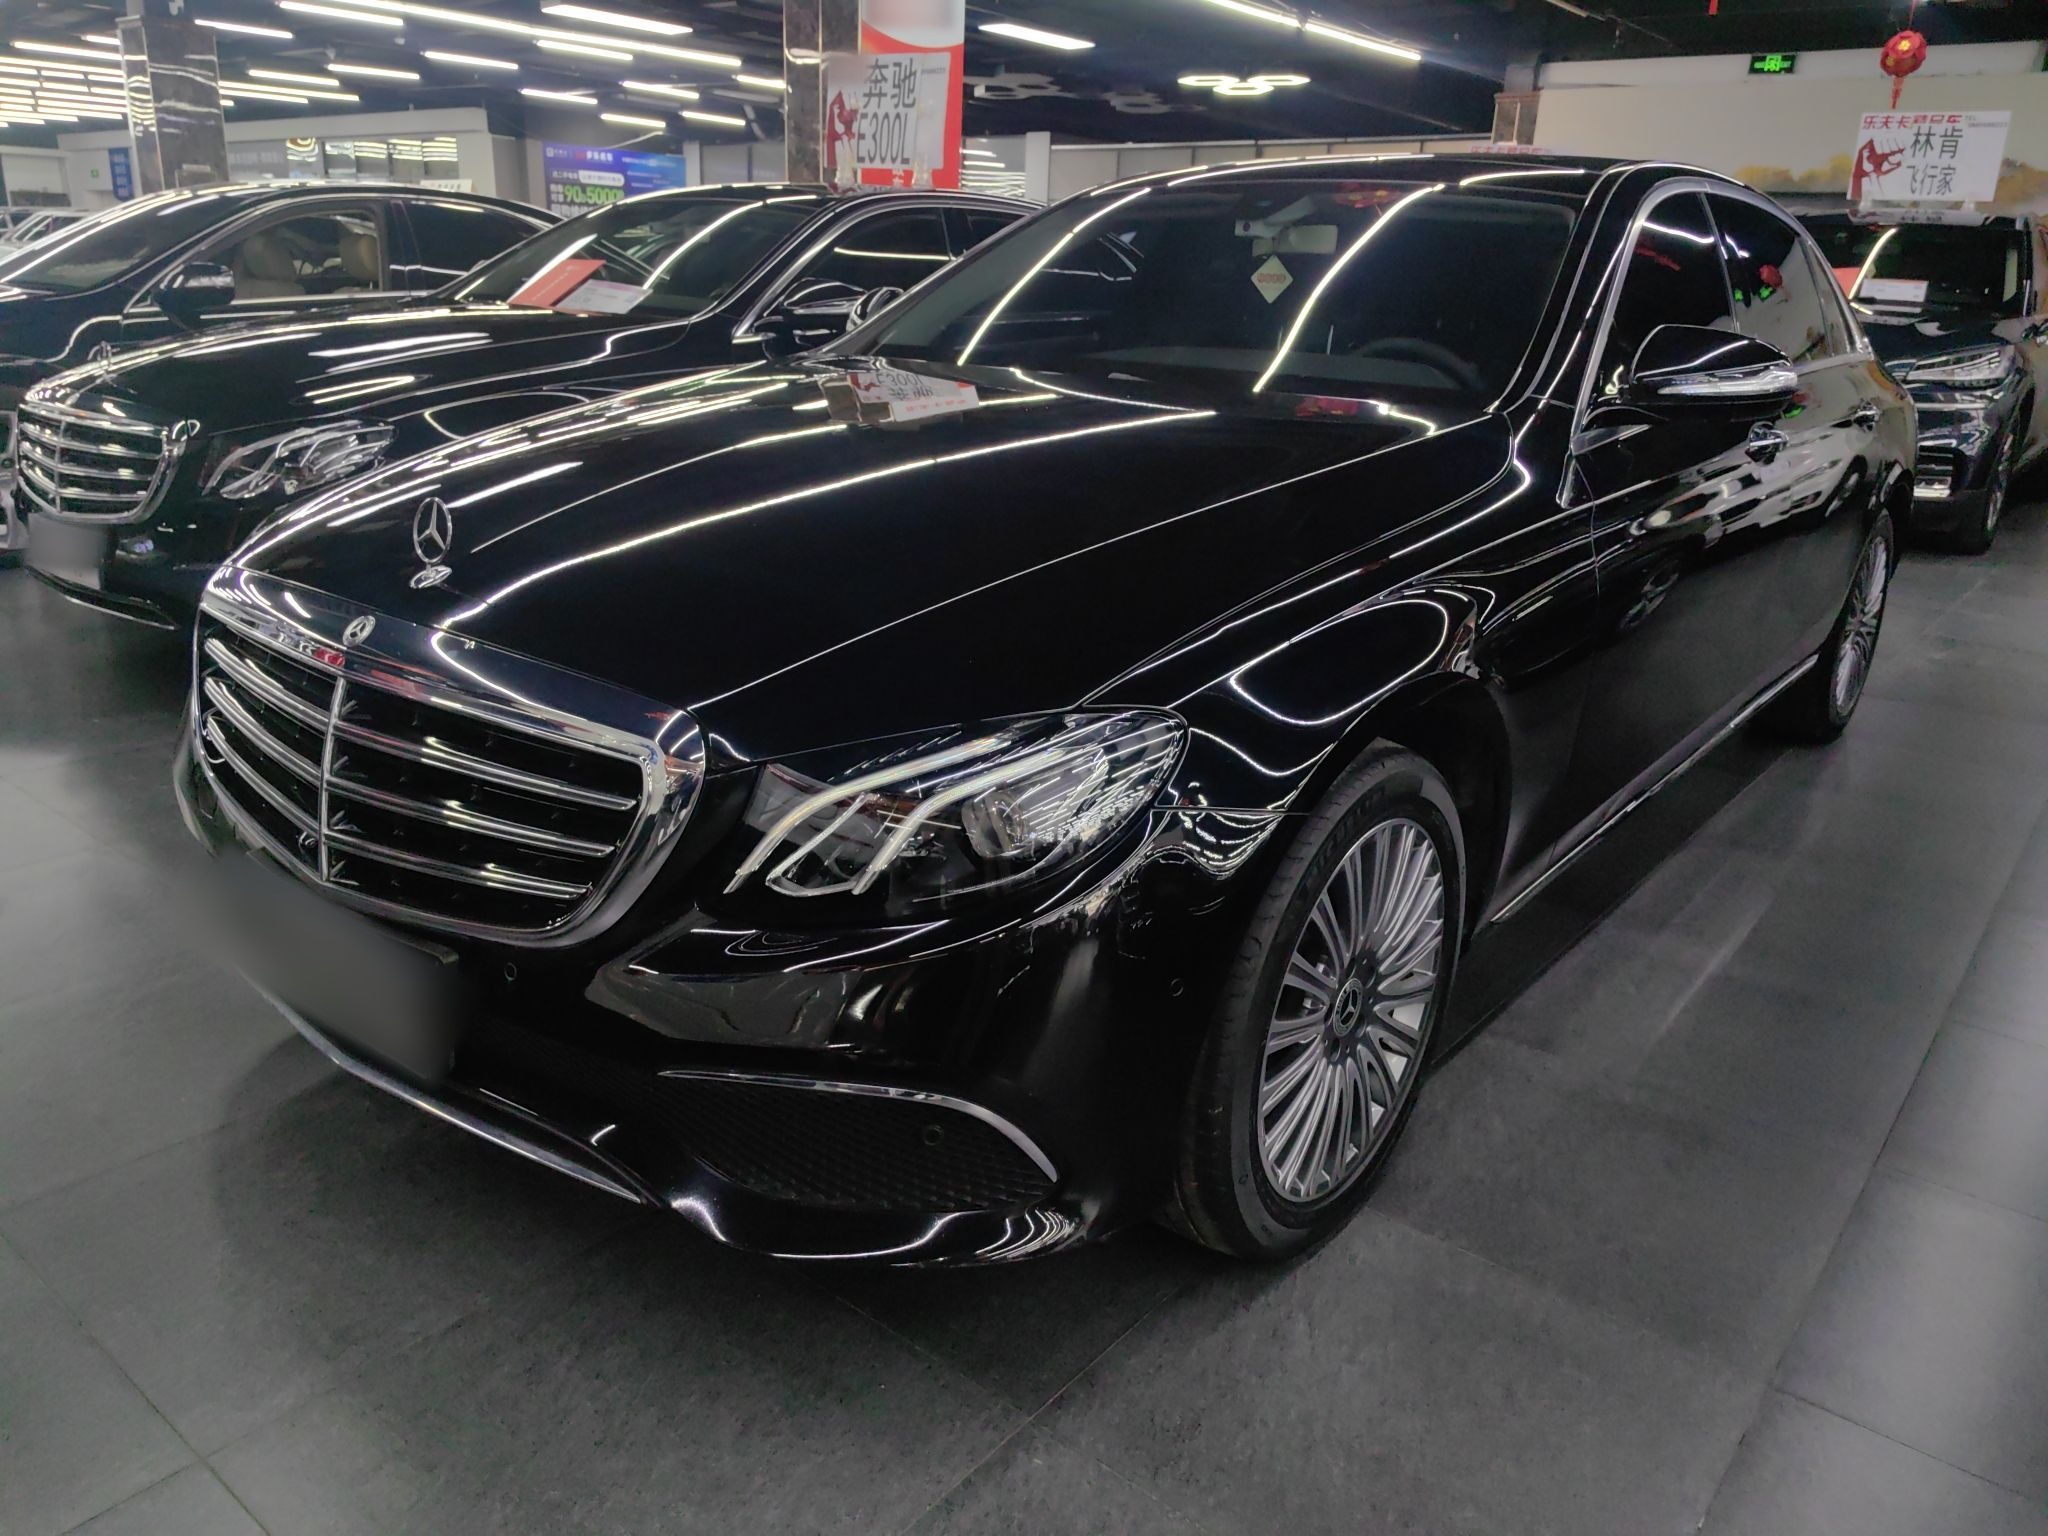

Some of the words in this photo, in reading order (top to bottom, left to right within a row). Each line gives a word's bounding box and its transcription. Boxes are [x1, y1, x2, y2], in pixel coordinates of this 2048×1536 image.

[862, 57, 918, 109] 奔驰
[856, 111, 911, 165] E300L
[1910, 126, 1963, 159] 林肯
[1906, 163, 1957, 196] 飞行家
